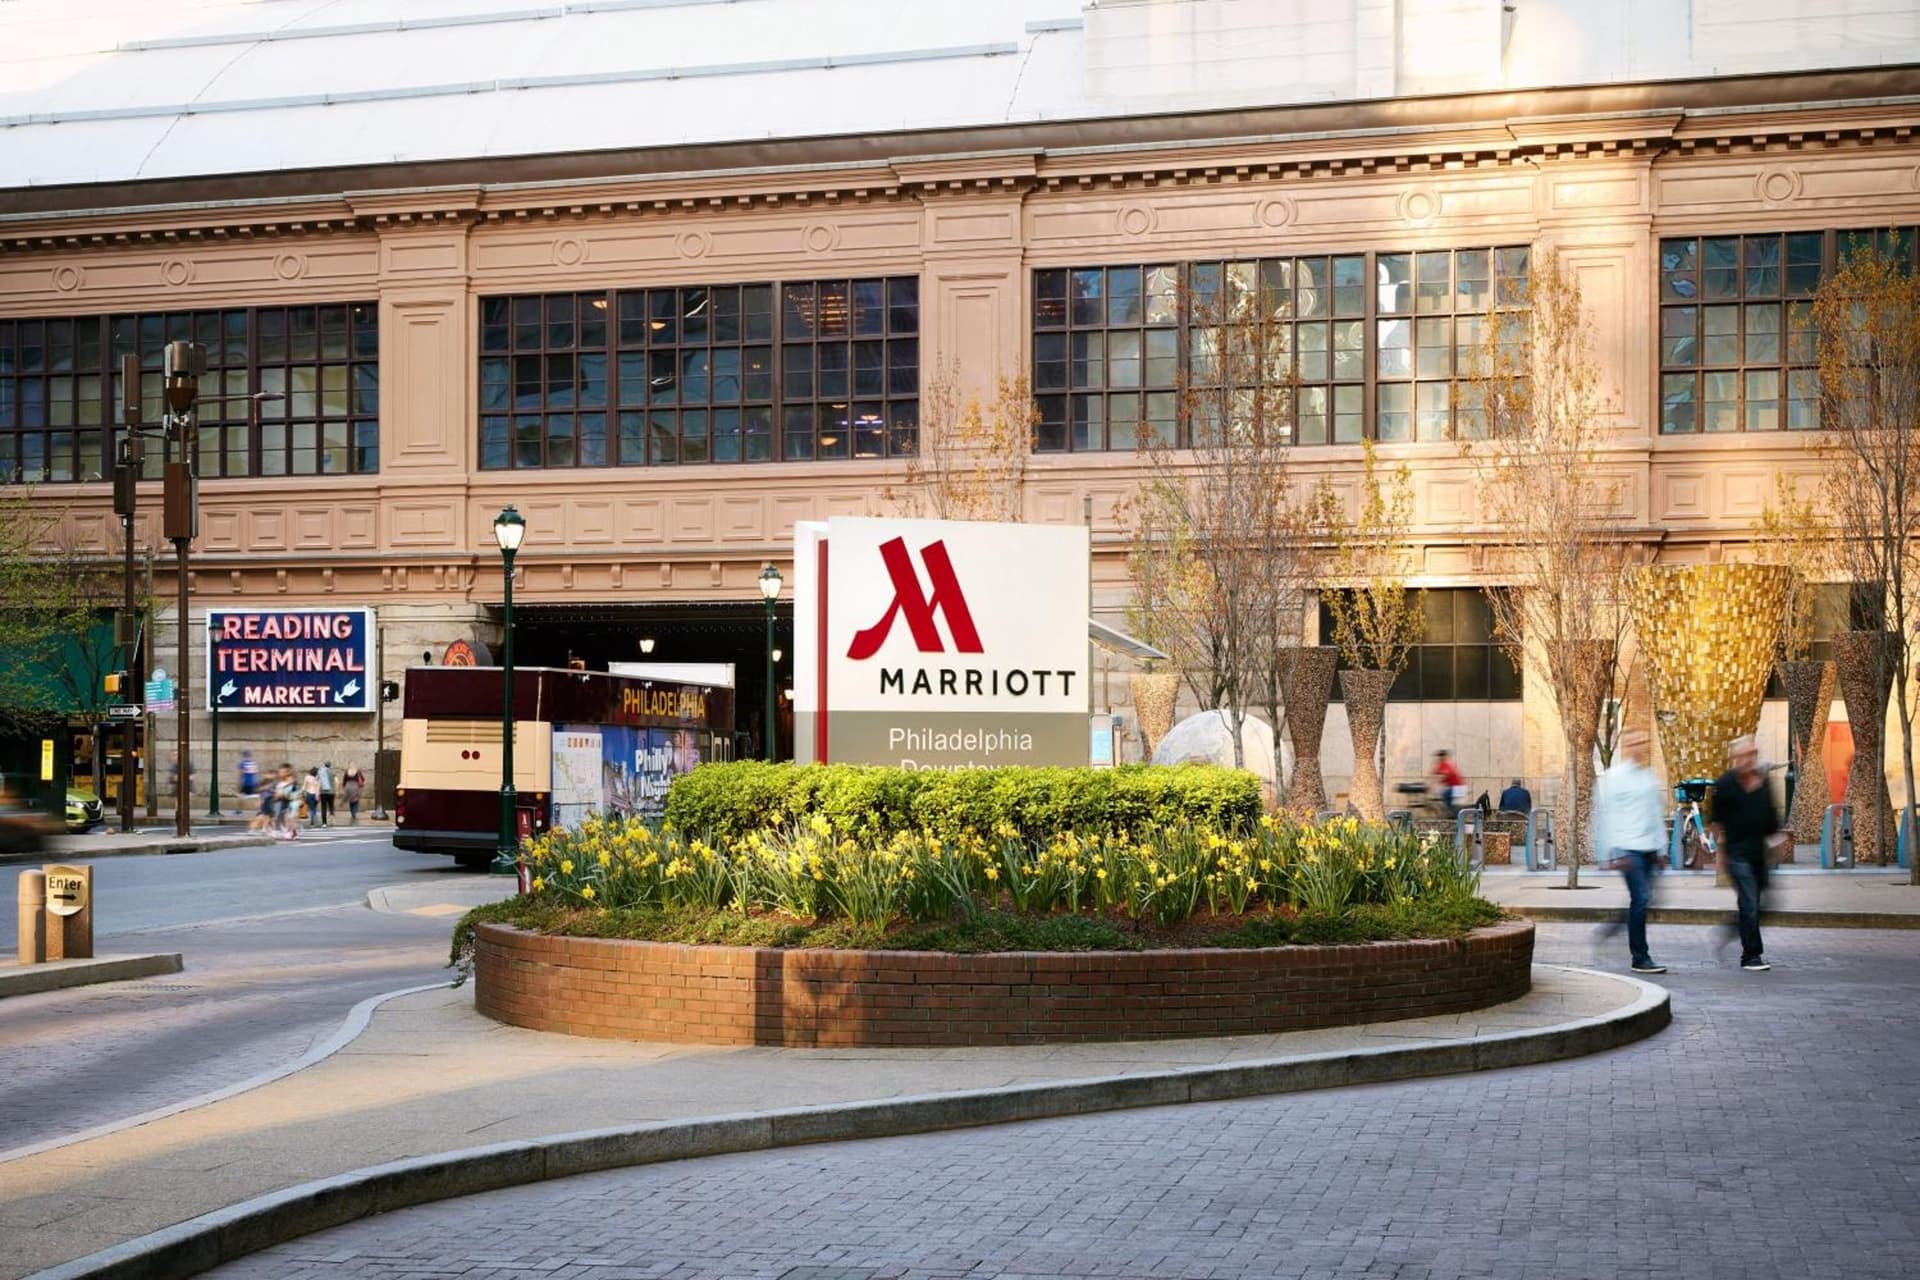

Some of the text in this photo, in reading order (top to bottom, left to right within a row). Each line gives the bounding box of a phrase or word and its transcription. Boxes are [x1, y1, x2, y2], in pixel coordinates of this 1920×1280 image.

[223, 614, 353, 640] READING
[217, 647, 365, 672] TERMINAL
[244, 685, 331, 705] MARKET
[879, 667, 1077, 697] MARRIOTT
[623, 688, 706, 718] PHILADELPHIA
[889, 727, 1033, 756] Philadelphia
[49, 876, 82, 891] Enter
